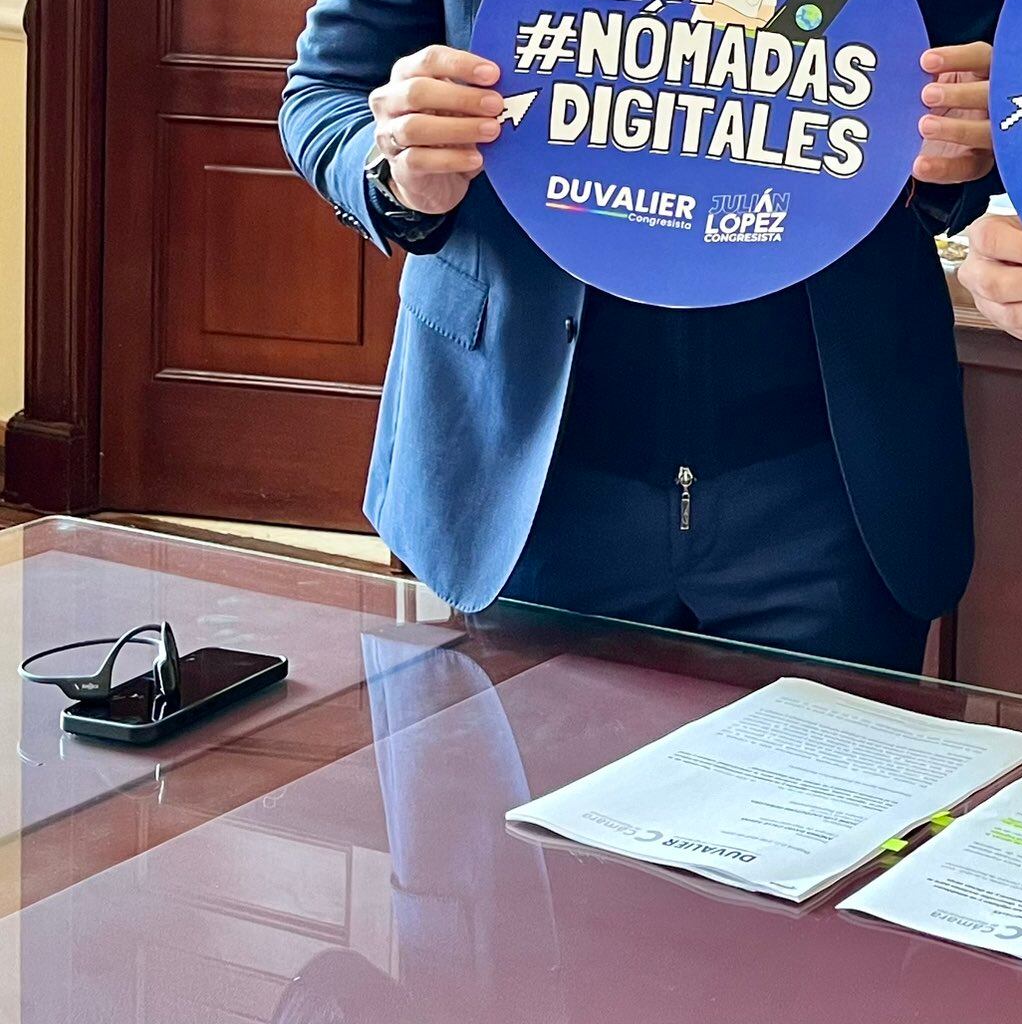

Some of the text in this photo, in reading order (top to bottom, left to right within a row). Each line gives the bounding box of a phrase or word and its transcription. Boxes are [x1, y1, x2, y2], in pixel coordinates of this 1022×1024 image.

[514, 0, 878, 109] #NÓMADAS
[547, 82, 870, 178] DIGITALES
[546, 175, 697, 220] DUVALIER
[709, 188, 790, 214] JULIÁN
[628, 212, 692, 230] Congresista
[704, 232, 782, 243] CONGRESISTA
[662, 838, 757, 863] DUVALIER
